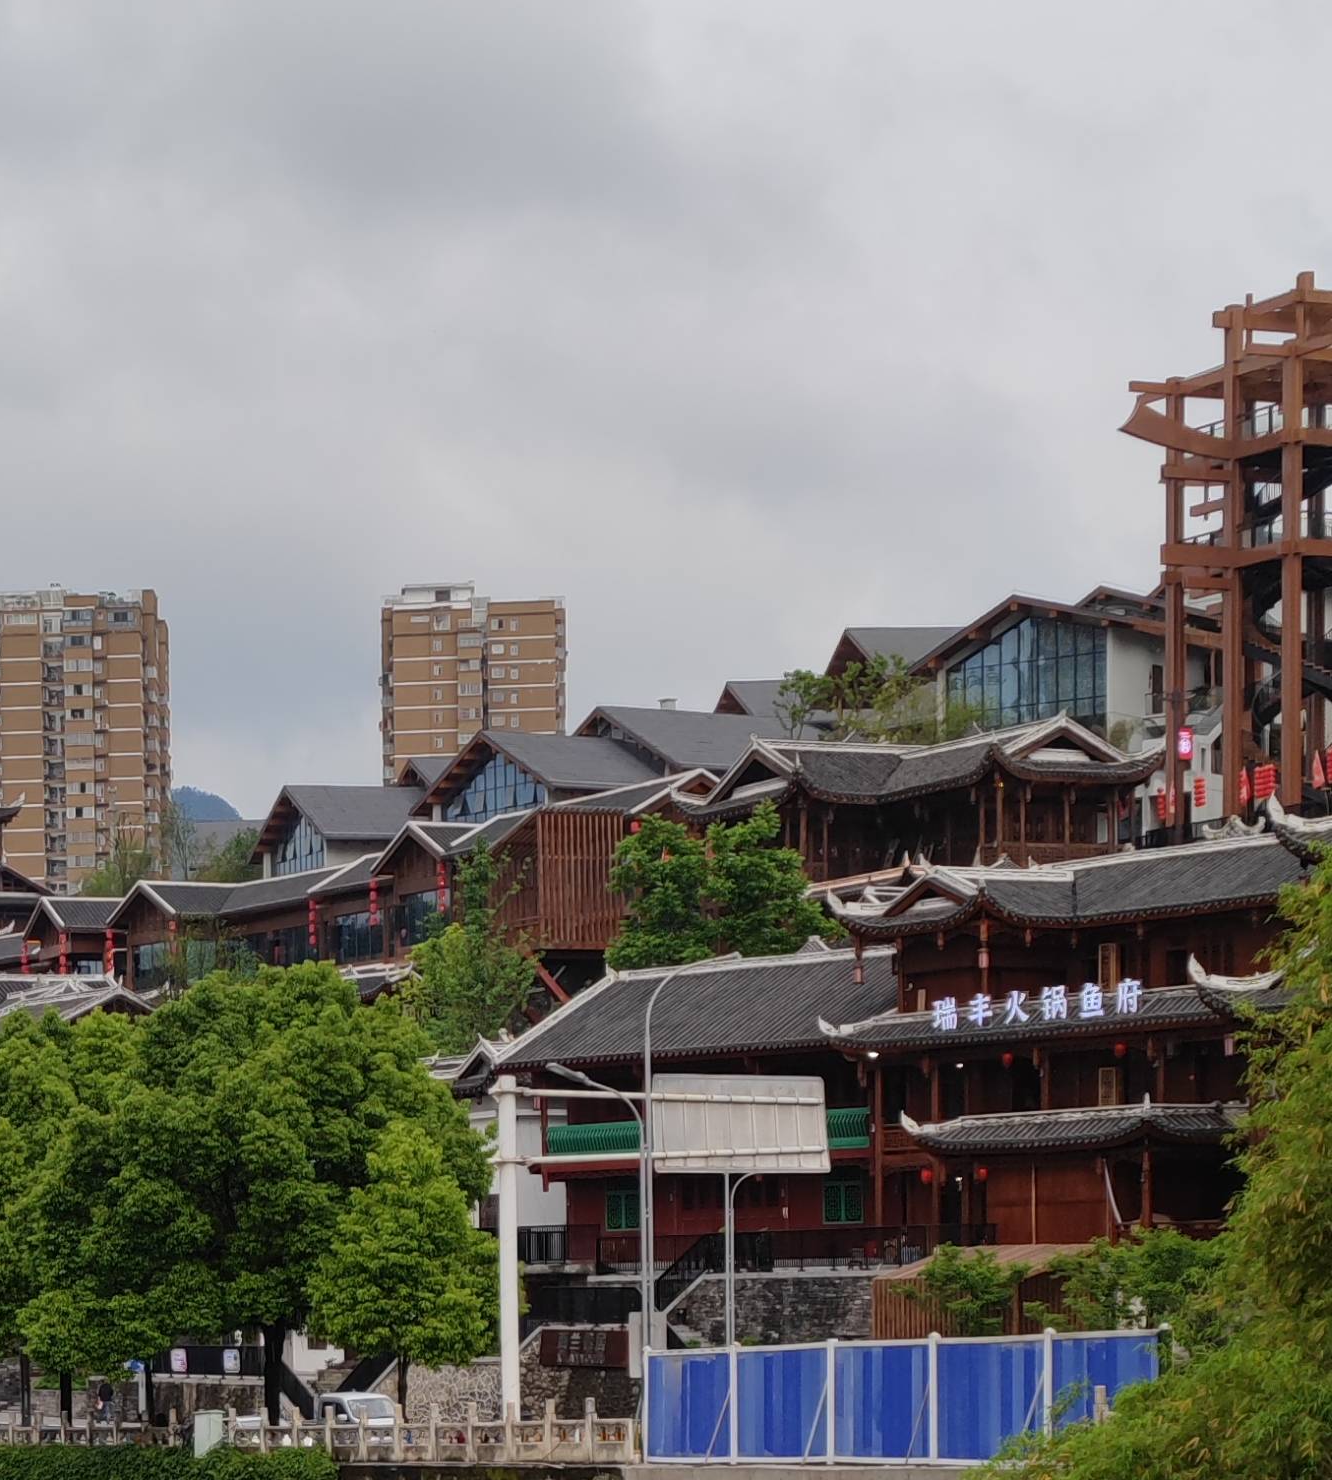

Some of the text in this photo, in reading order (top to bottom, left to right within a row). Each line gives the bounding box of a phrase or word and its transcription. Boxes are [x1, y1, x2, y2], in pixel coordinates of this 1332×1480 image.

[931, 977, 1143, 1031] 瑞丰火锅鱼府
